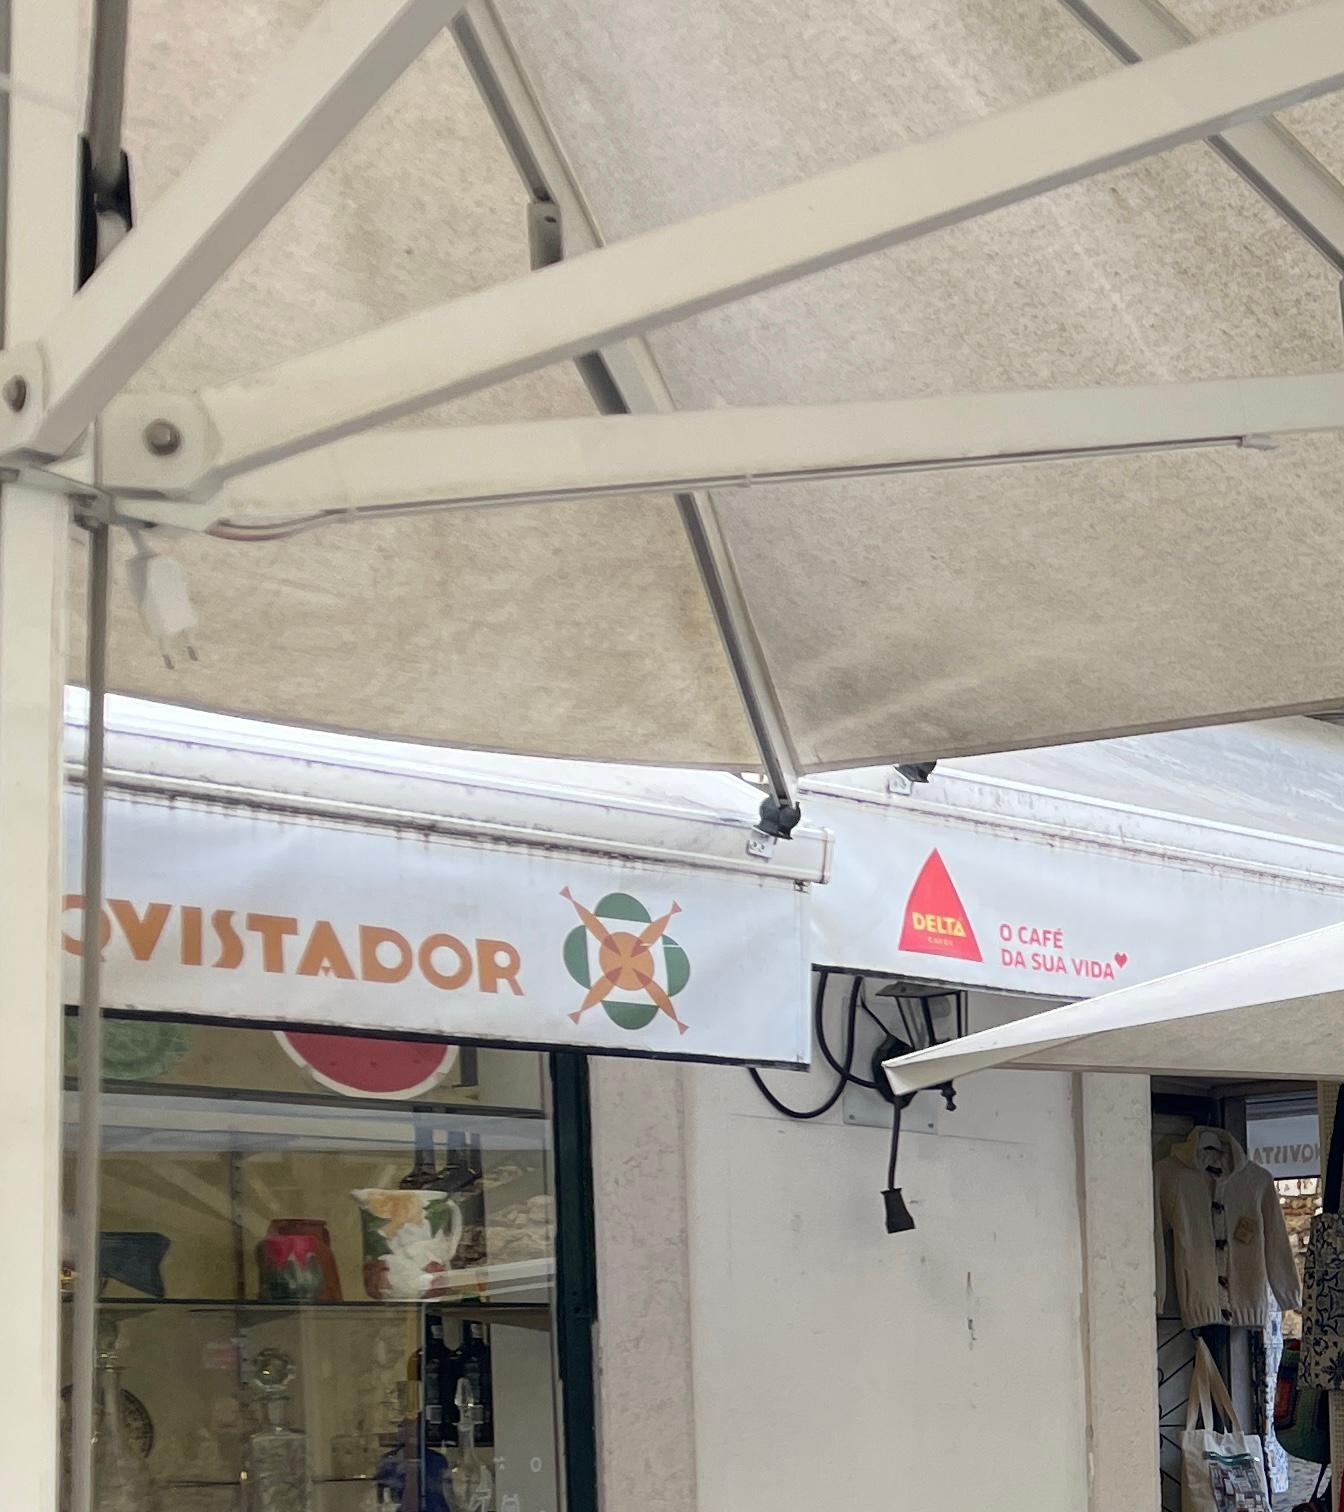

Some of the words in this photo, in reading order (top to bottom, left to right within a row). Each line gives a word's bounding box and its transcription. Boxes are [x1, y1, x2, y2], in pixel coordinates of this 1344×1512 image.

[911, 911, 967, 937] DELTA
[1000, 923, 1013, 942] O
[1017, 926, 1064, 949] CAFÉ
[1001, 948, 1027, 969] DA
[1031, 952, 1068, 975] SUA
[1071, 957, 1116, 980] VIDA
